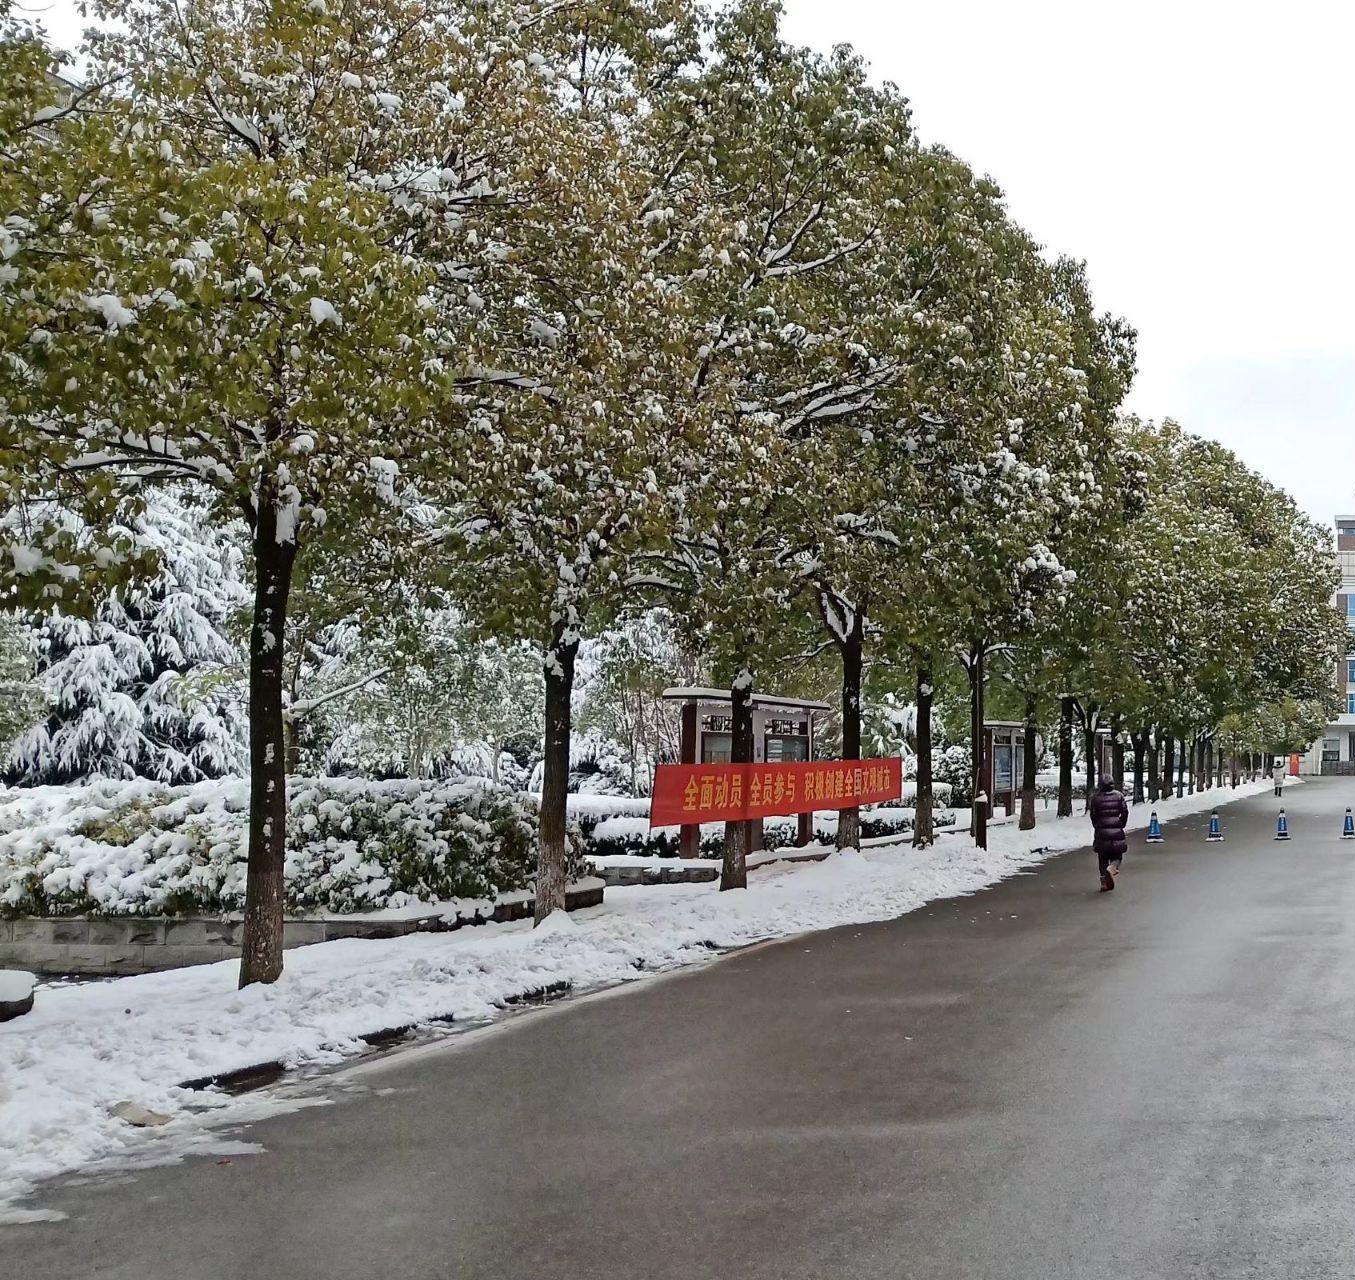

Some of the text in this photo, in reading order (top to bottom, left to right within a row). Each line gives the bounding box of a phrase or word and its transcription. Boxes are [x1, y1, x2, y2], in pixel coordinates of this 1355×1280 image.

[683, 767, 890, 811] 全面动员 全员参与 积极创建全国文明城市
